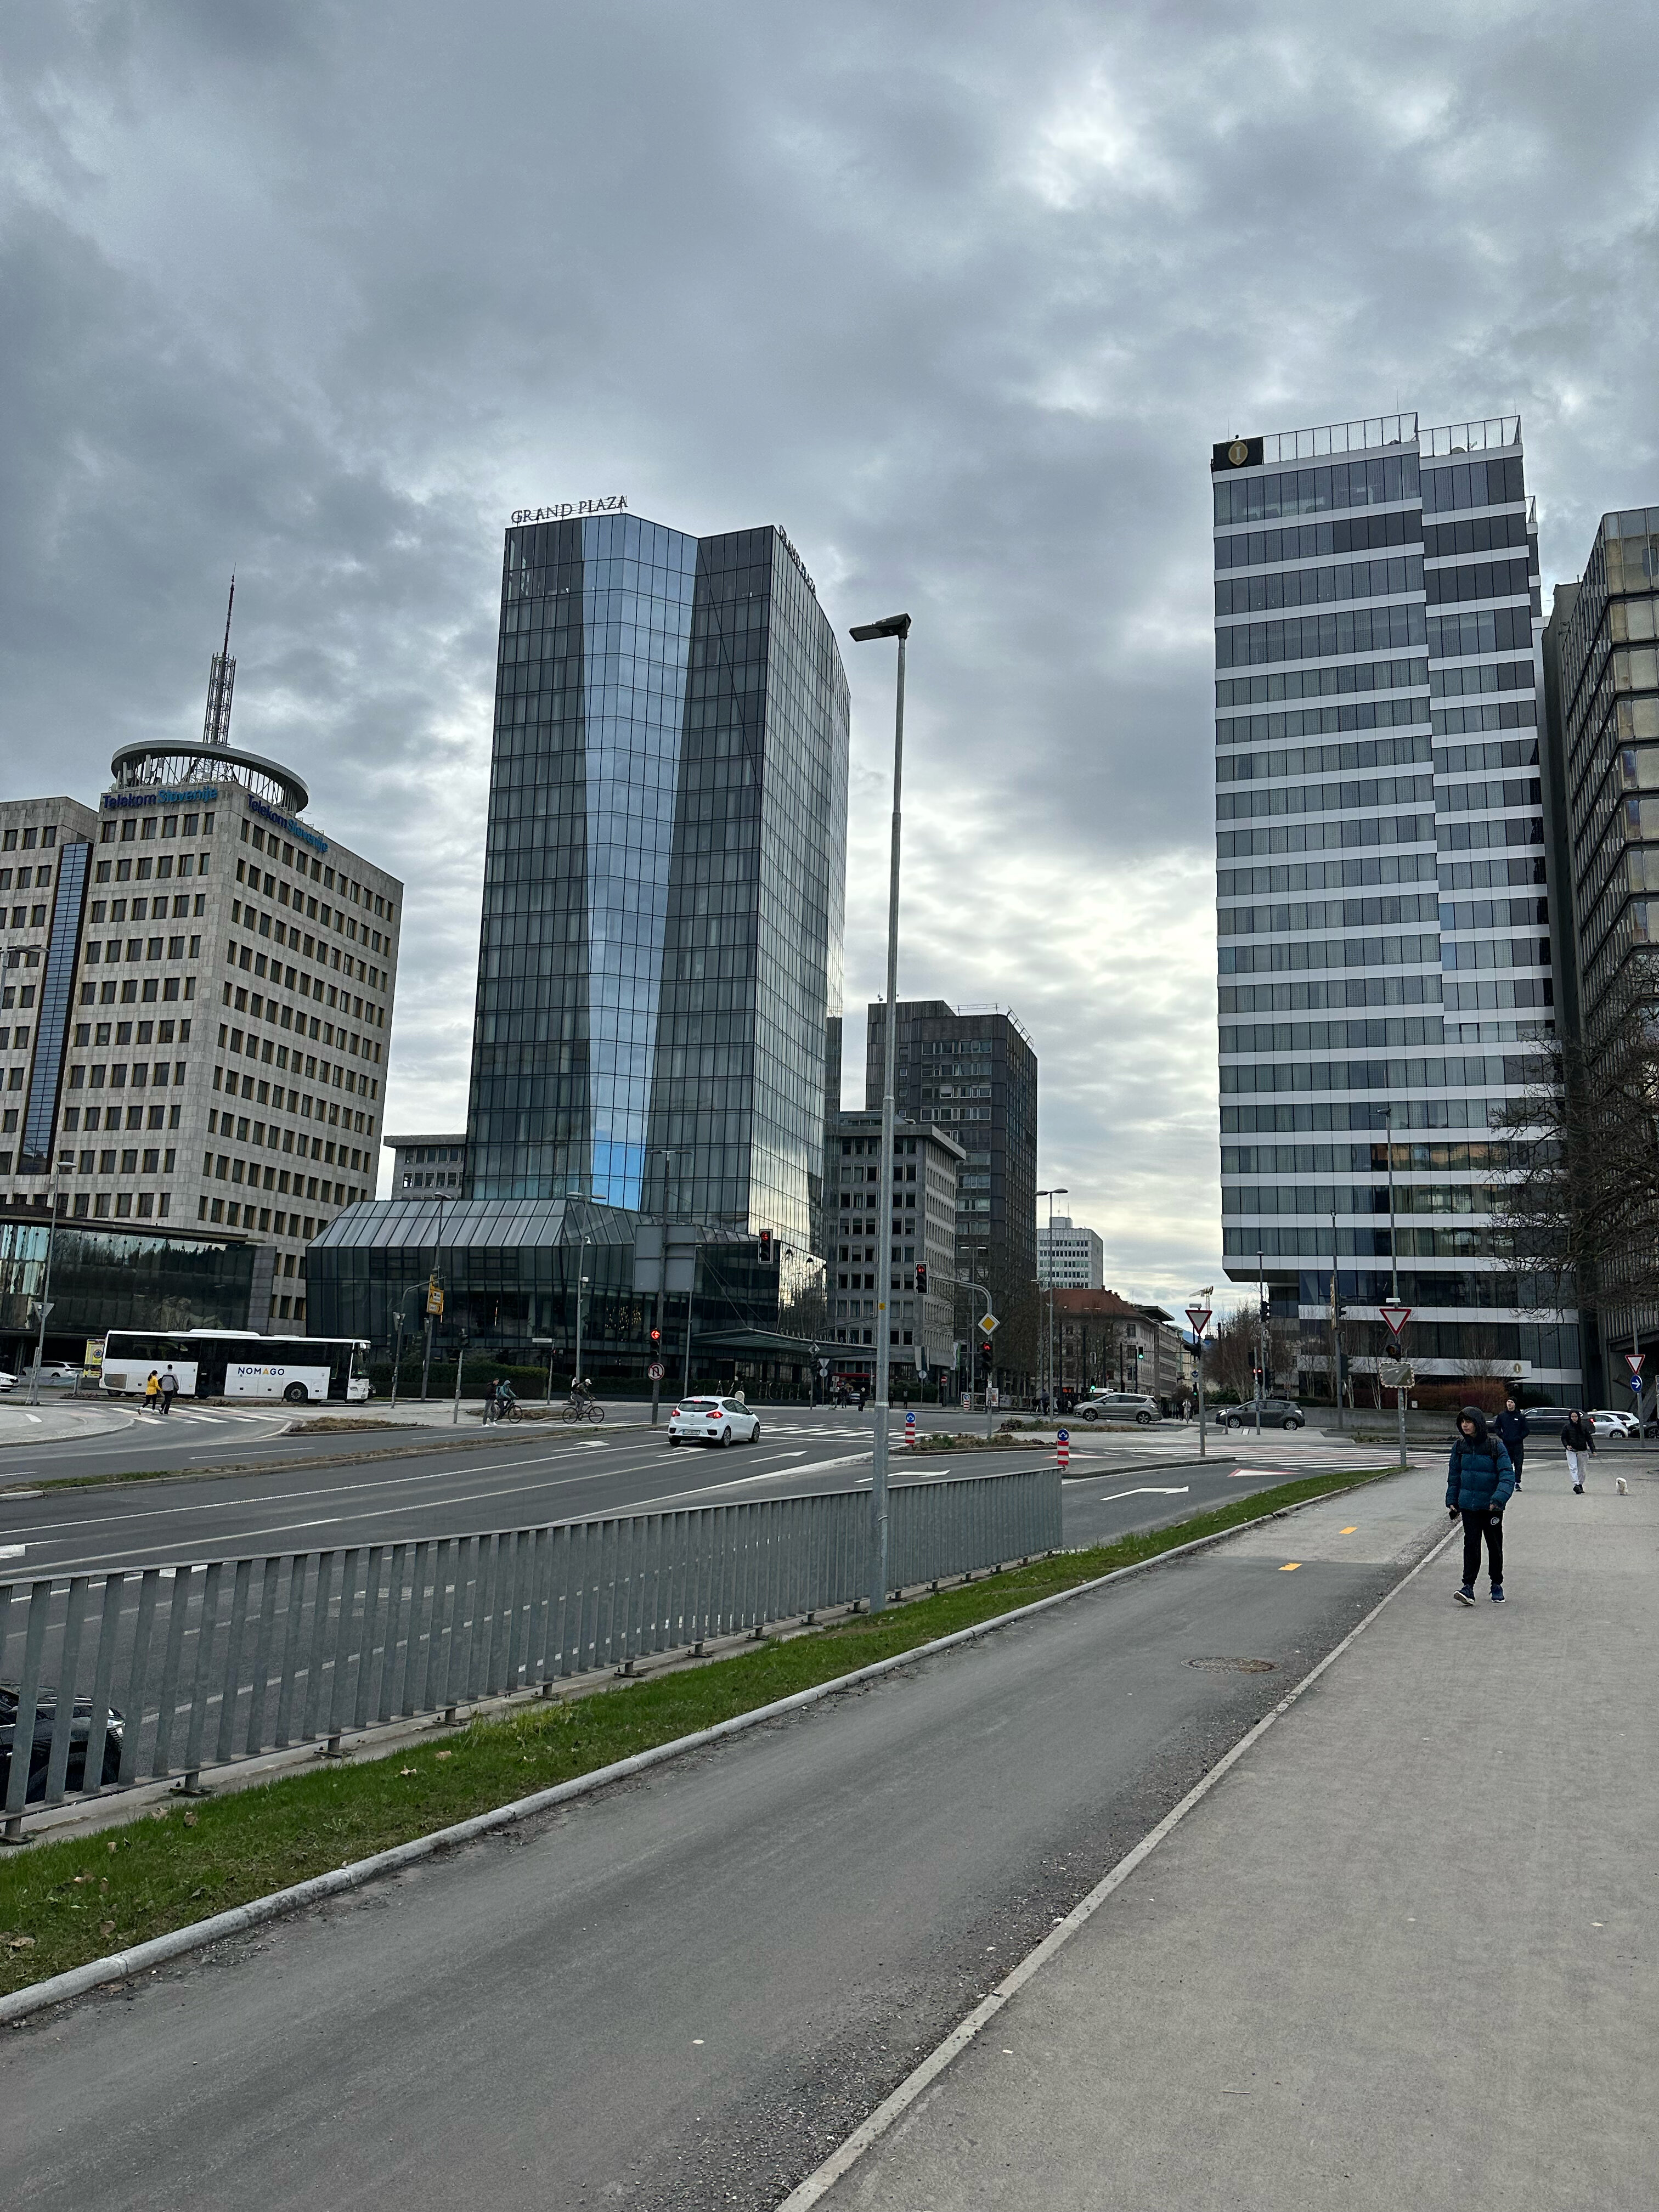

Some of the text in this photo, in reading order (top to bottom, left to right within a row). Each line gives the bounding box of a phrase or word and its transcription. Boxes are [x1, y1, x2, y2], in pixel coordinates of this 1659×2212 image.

[511, 495, 628, 523] GRAND PLAZA
[238, 1367, 285, 1375] NOMAGO
